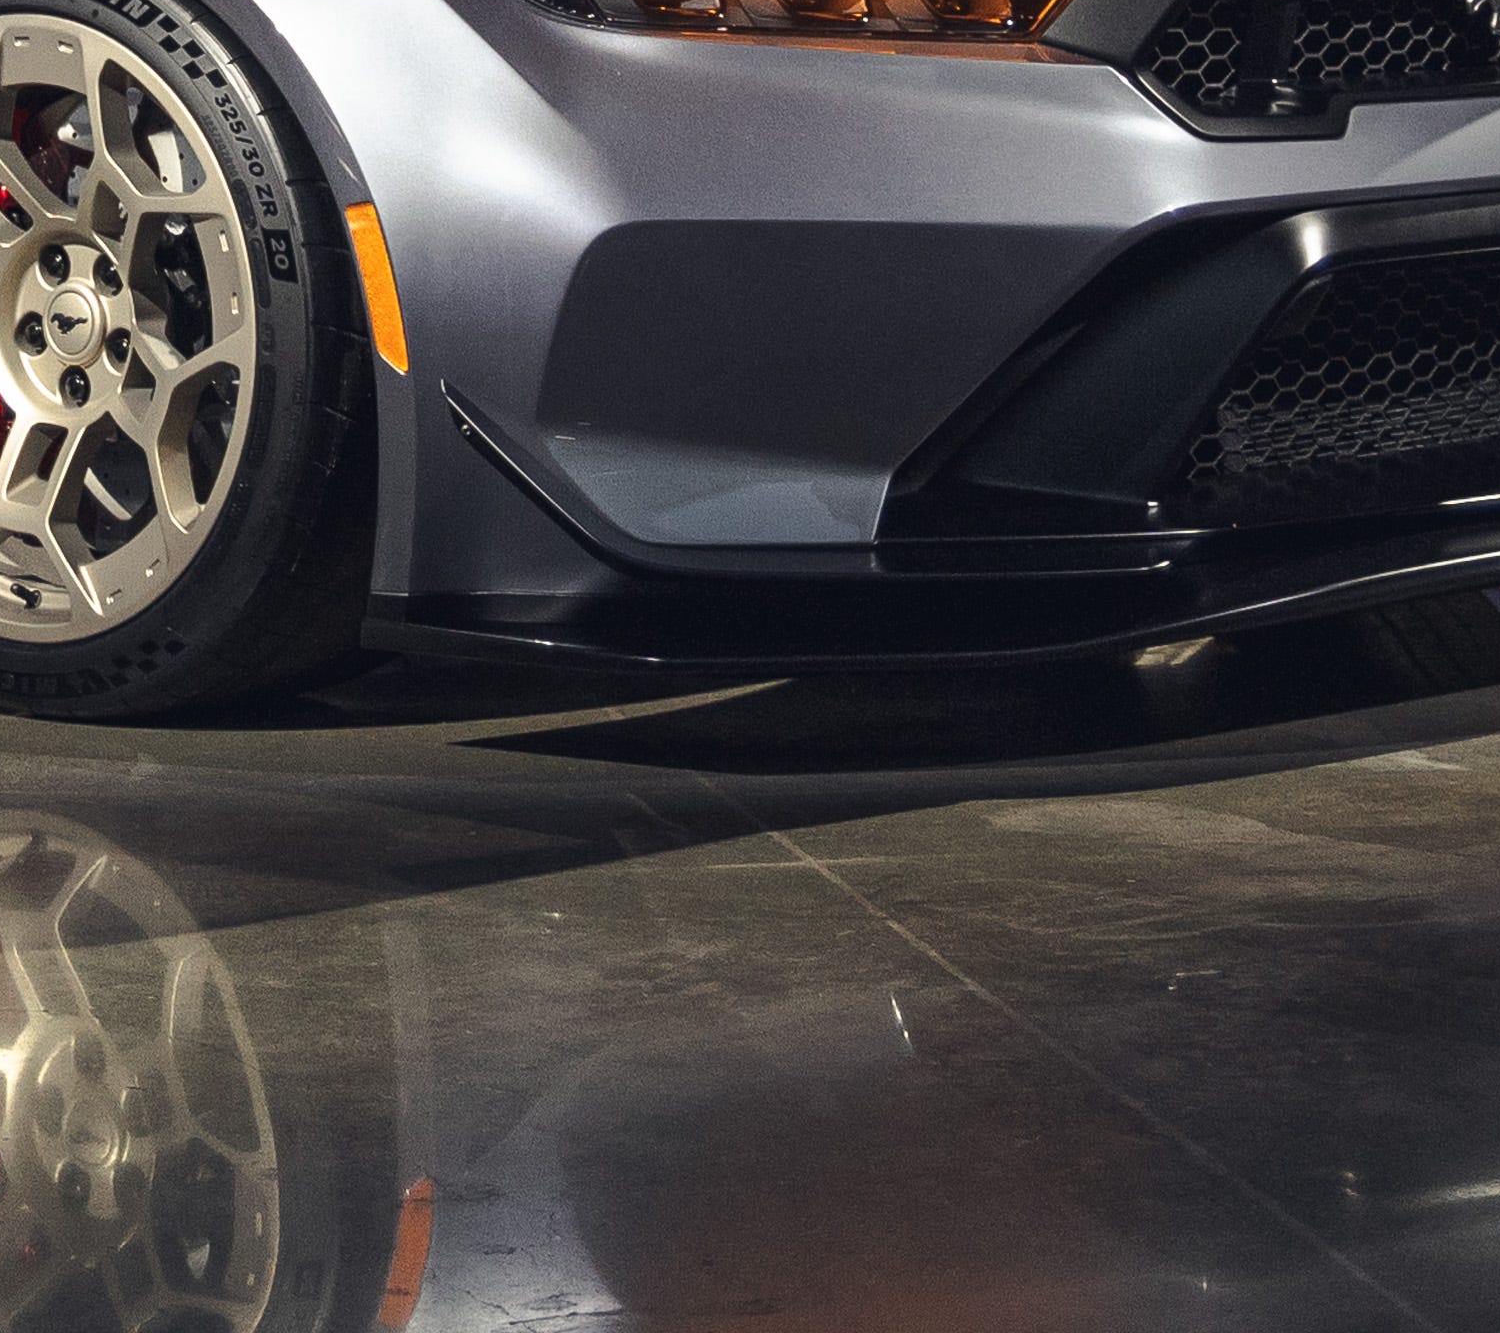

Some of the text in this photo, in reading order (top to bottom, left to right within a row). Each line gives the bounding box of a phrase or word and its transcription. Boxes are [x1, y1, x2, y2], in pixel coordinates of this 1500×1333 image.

[214, 92, 265, 178] 325/30
[254, 183, 278, 218] ZR
[269, 237, 290, 271] 20
